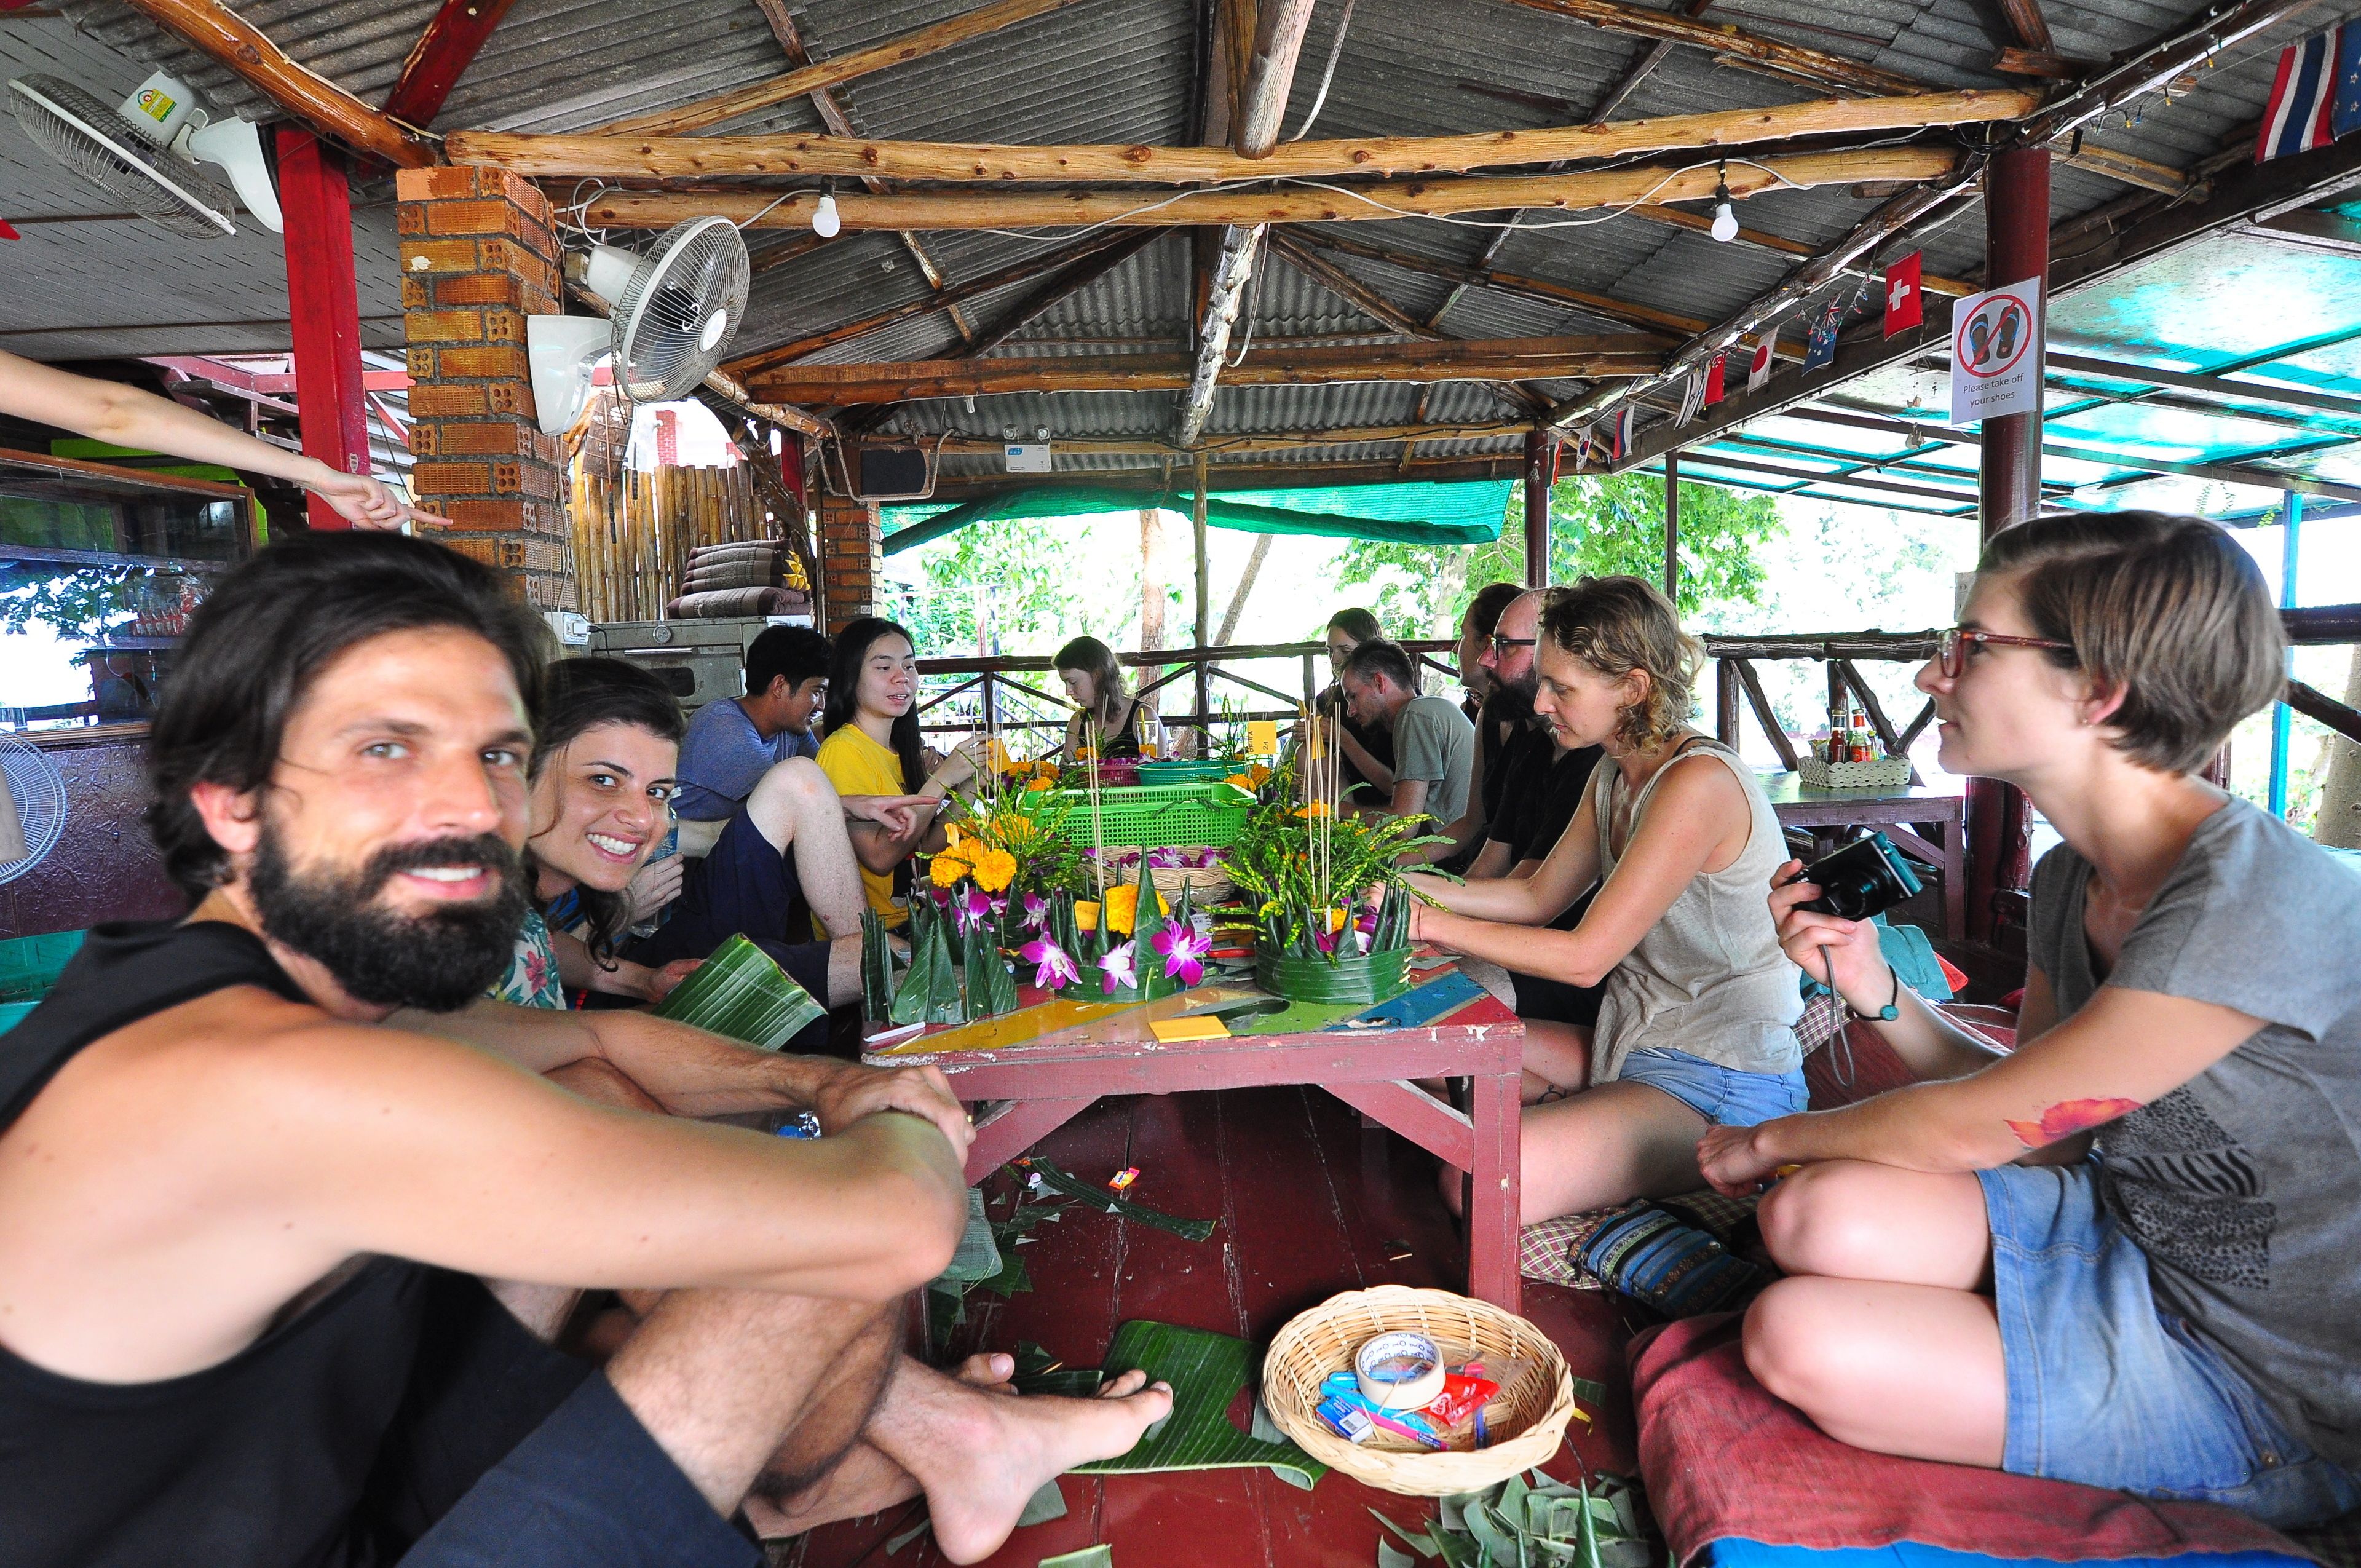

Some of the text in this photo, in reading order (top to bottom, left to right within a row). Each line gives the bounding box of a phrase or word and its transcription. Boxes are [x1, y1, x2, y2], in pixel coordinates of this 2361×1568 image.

[1963, 373, 2024, 394] Please take off
[1970, 391, 2015, 408] your shoes
